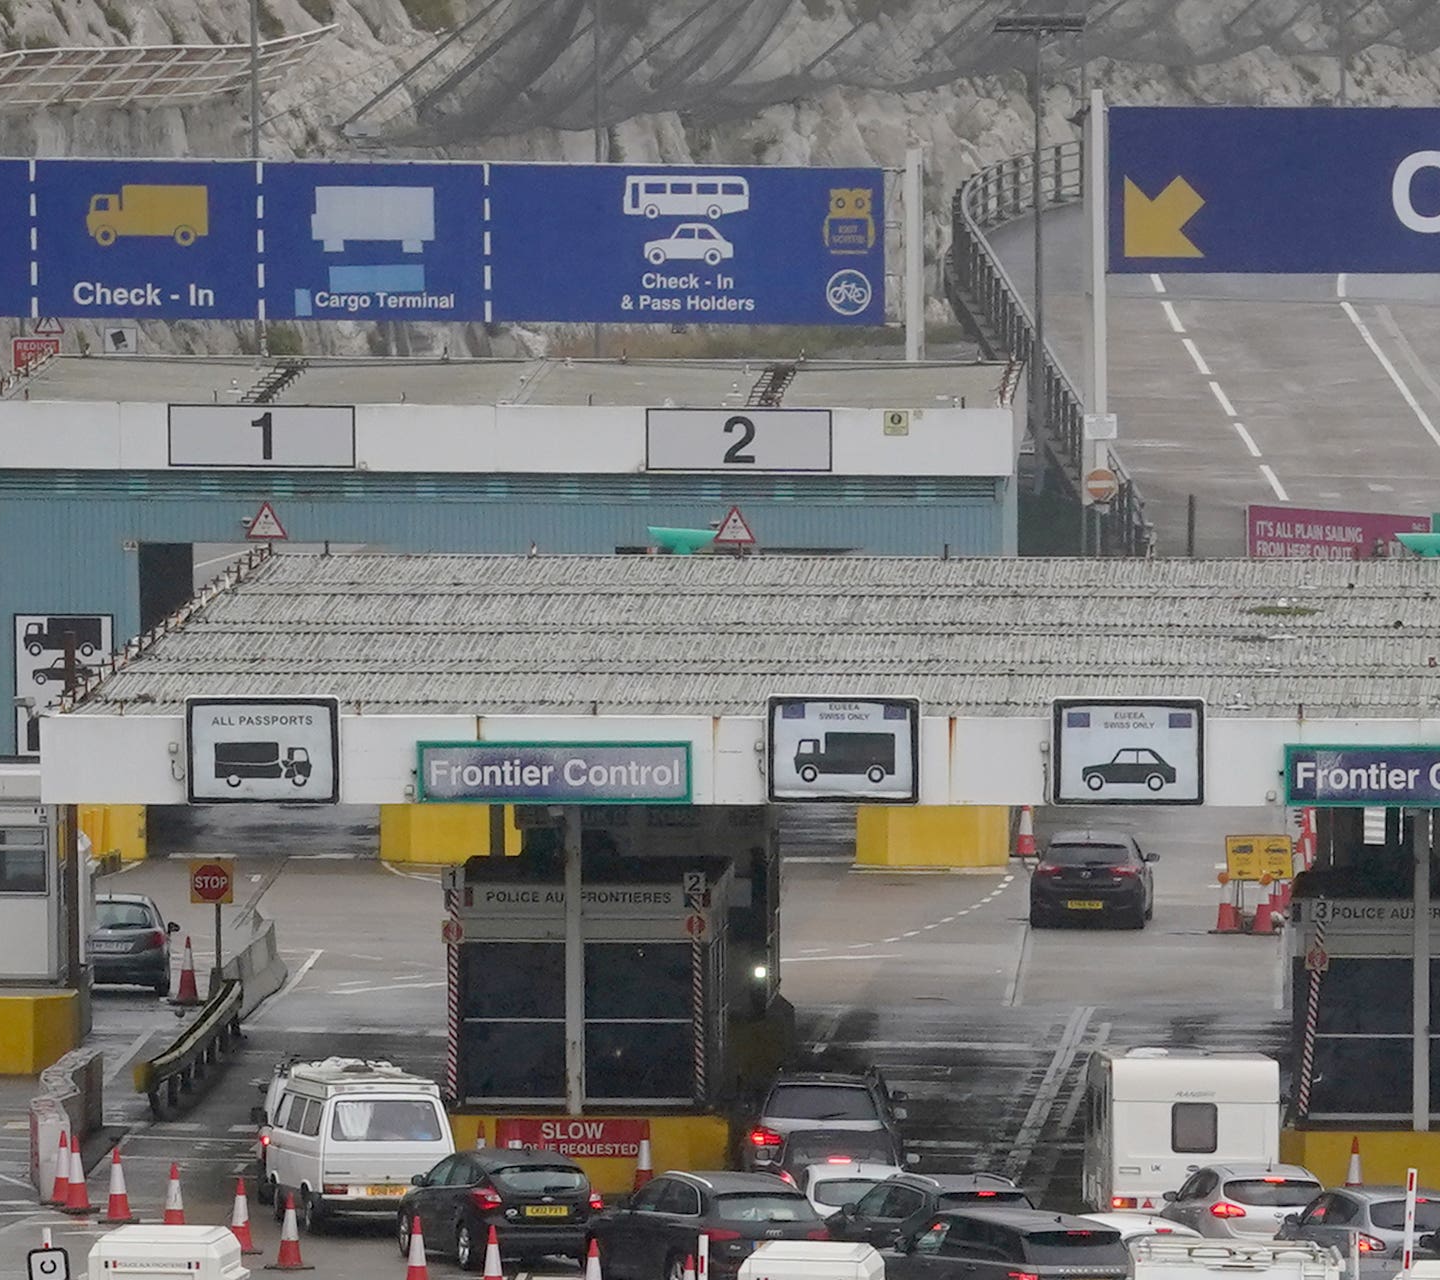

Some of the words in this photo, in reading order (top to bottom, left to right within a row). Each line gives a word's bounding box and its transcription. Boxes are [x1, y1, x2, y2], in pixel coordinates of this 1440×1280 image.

[641, 272, 685, 290] Check
[712, 272, 735, 290] In
[72, 281, 163, 308] Check
[187, 283, 216, 307] In
[314, 290, 374, 314] Cargo
[379, 290, 455, 310] Terminal
[621, 294, 636, 312] &
[640, 293, 669, 312] Pass
[674, 293, 756, 312] Holders
[249, 413, 275, 462] 1
[723, 416, 757, 465] 2
[1256, 521, 1273, 535] IT'S
[1275, 523, 1292, 537] ALL
[1294, 524, 1326, 540] PLAIN
[1329, 526, 1363, 543] SAILING
[212, 715, 235, 725] ALL
[239, 715, 313, 726] PASSPORTS
[819, 713, 846, 721] SWISS
[848, 713, 870, 721] ONLY
[1103, 721, 1129, 729] SWISS
[1130, 721, 1155, 729] ONLY
[430, 759, 554, 790] Frontier
[565, 758, 682, 788] Control
[1296, 761, 1420, 792] Frontier
[195, 877, 227, 889] STOP
[449, 870, 456, 887] 1
[688, 875, 700, 892] 2
[1313, 902, 1328, 920] 3
[541, 1122, 604, 1140] SLOW
[559, 1143, 639, 1156] REQUESTED
[40, 1260, 57, 1274] C
